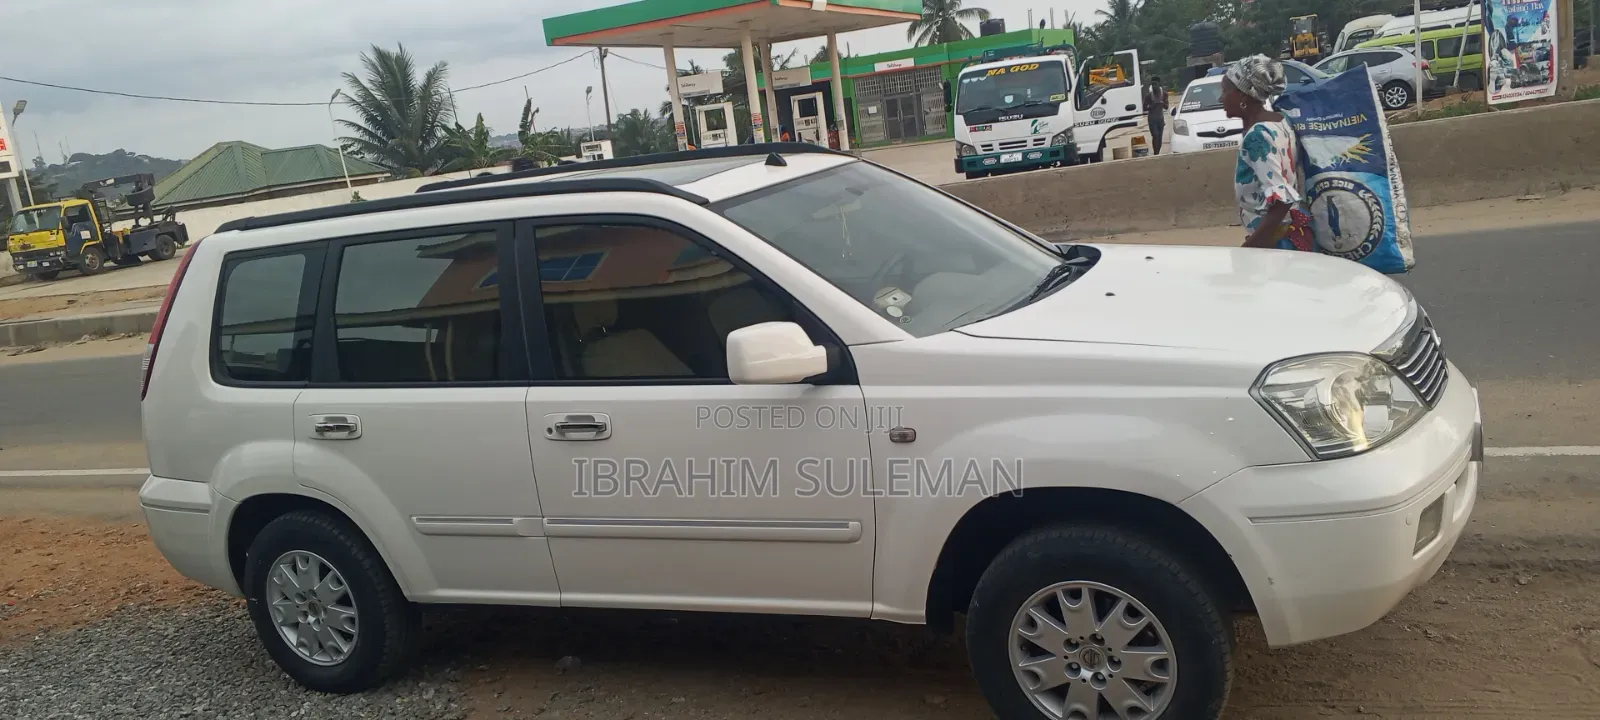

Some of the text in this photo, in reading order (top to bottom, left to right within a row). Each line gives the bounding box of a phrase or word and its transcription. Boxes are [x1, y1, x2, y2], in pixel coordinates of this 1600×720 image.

[987, 62, 1040, 77] NA GOD
[998, 113, 1024, 122] ISUZU
[1293, 114, 1367, 131] VIETNAMESE RI
[1332, 179, 1355, 190] RICE
